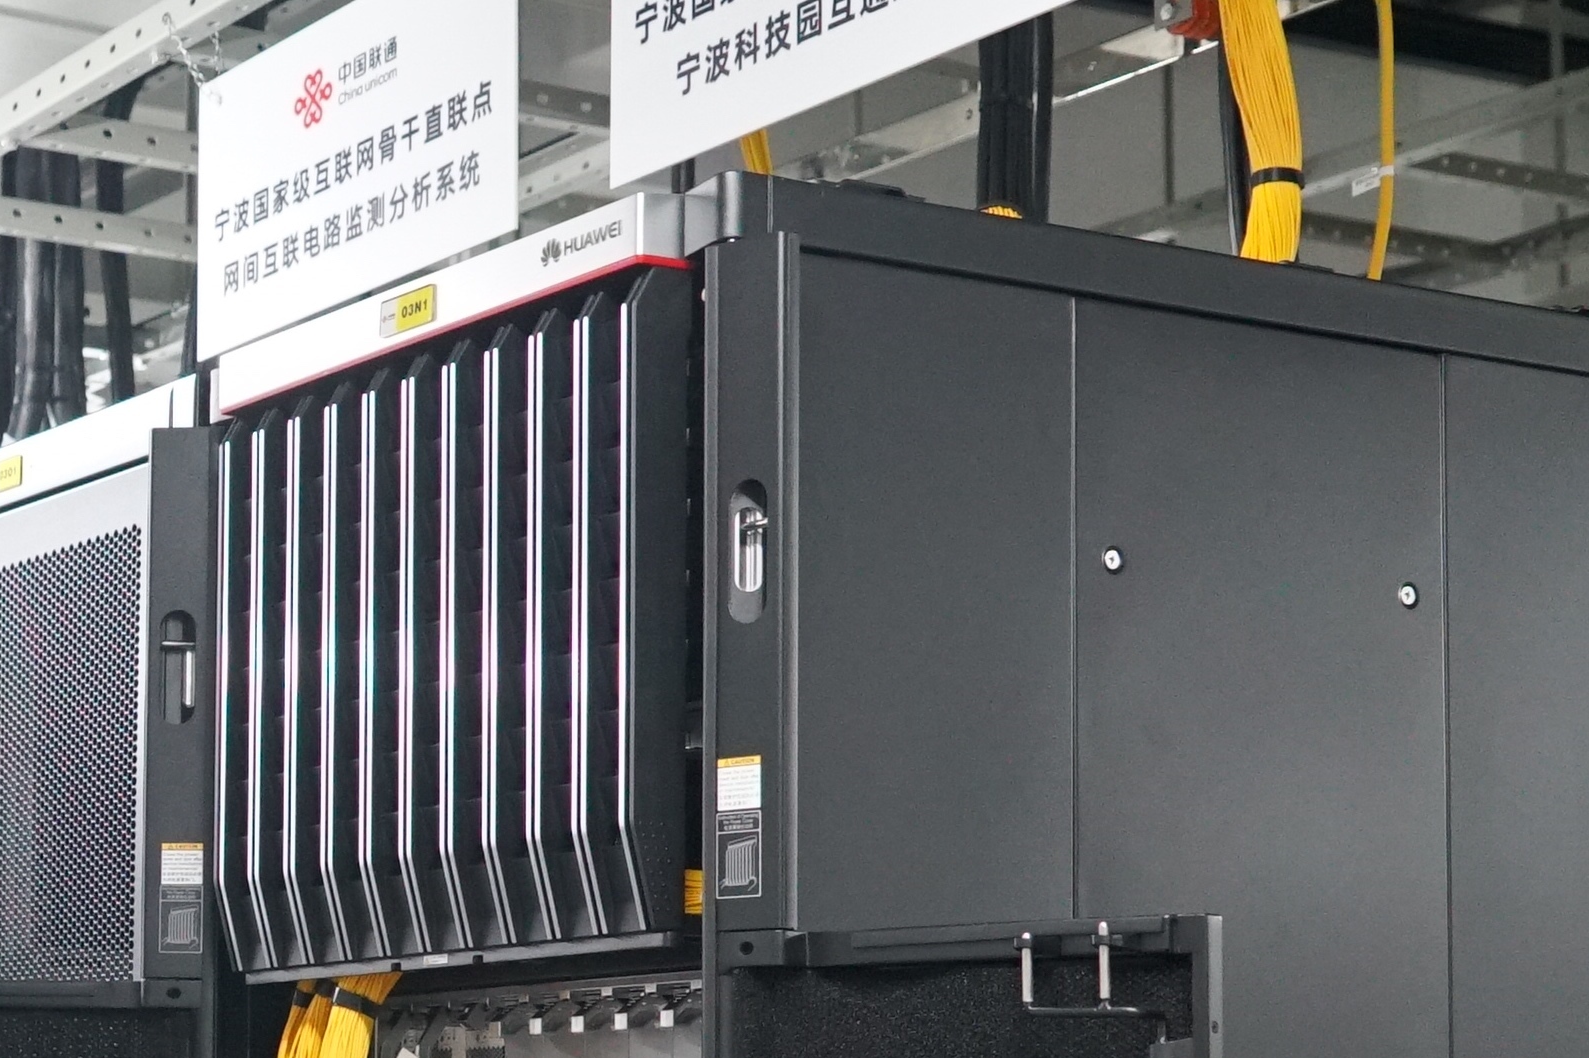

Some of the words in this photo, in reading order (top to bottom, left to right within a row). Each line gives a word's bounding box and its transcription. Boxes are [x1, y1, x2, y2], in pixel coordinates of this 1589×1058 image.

[338, 36, 397, 85] 中国联通
[364, 68, 398, 92] unicom
[214, 80, 493, 242] 宁波国家级互联网骨干直联点
[223, 150, 481, 297] 网间互联电路监测分析系统
[563, 219, 623, 256] HUAWEI
[401, 299, 428, 318] 03N1
